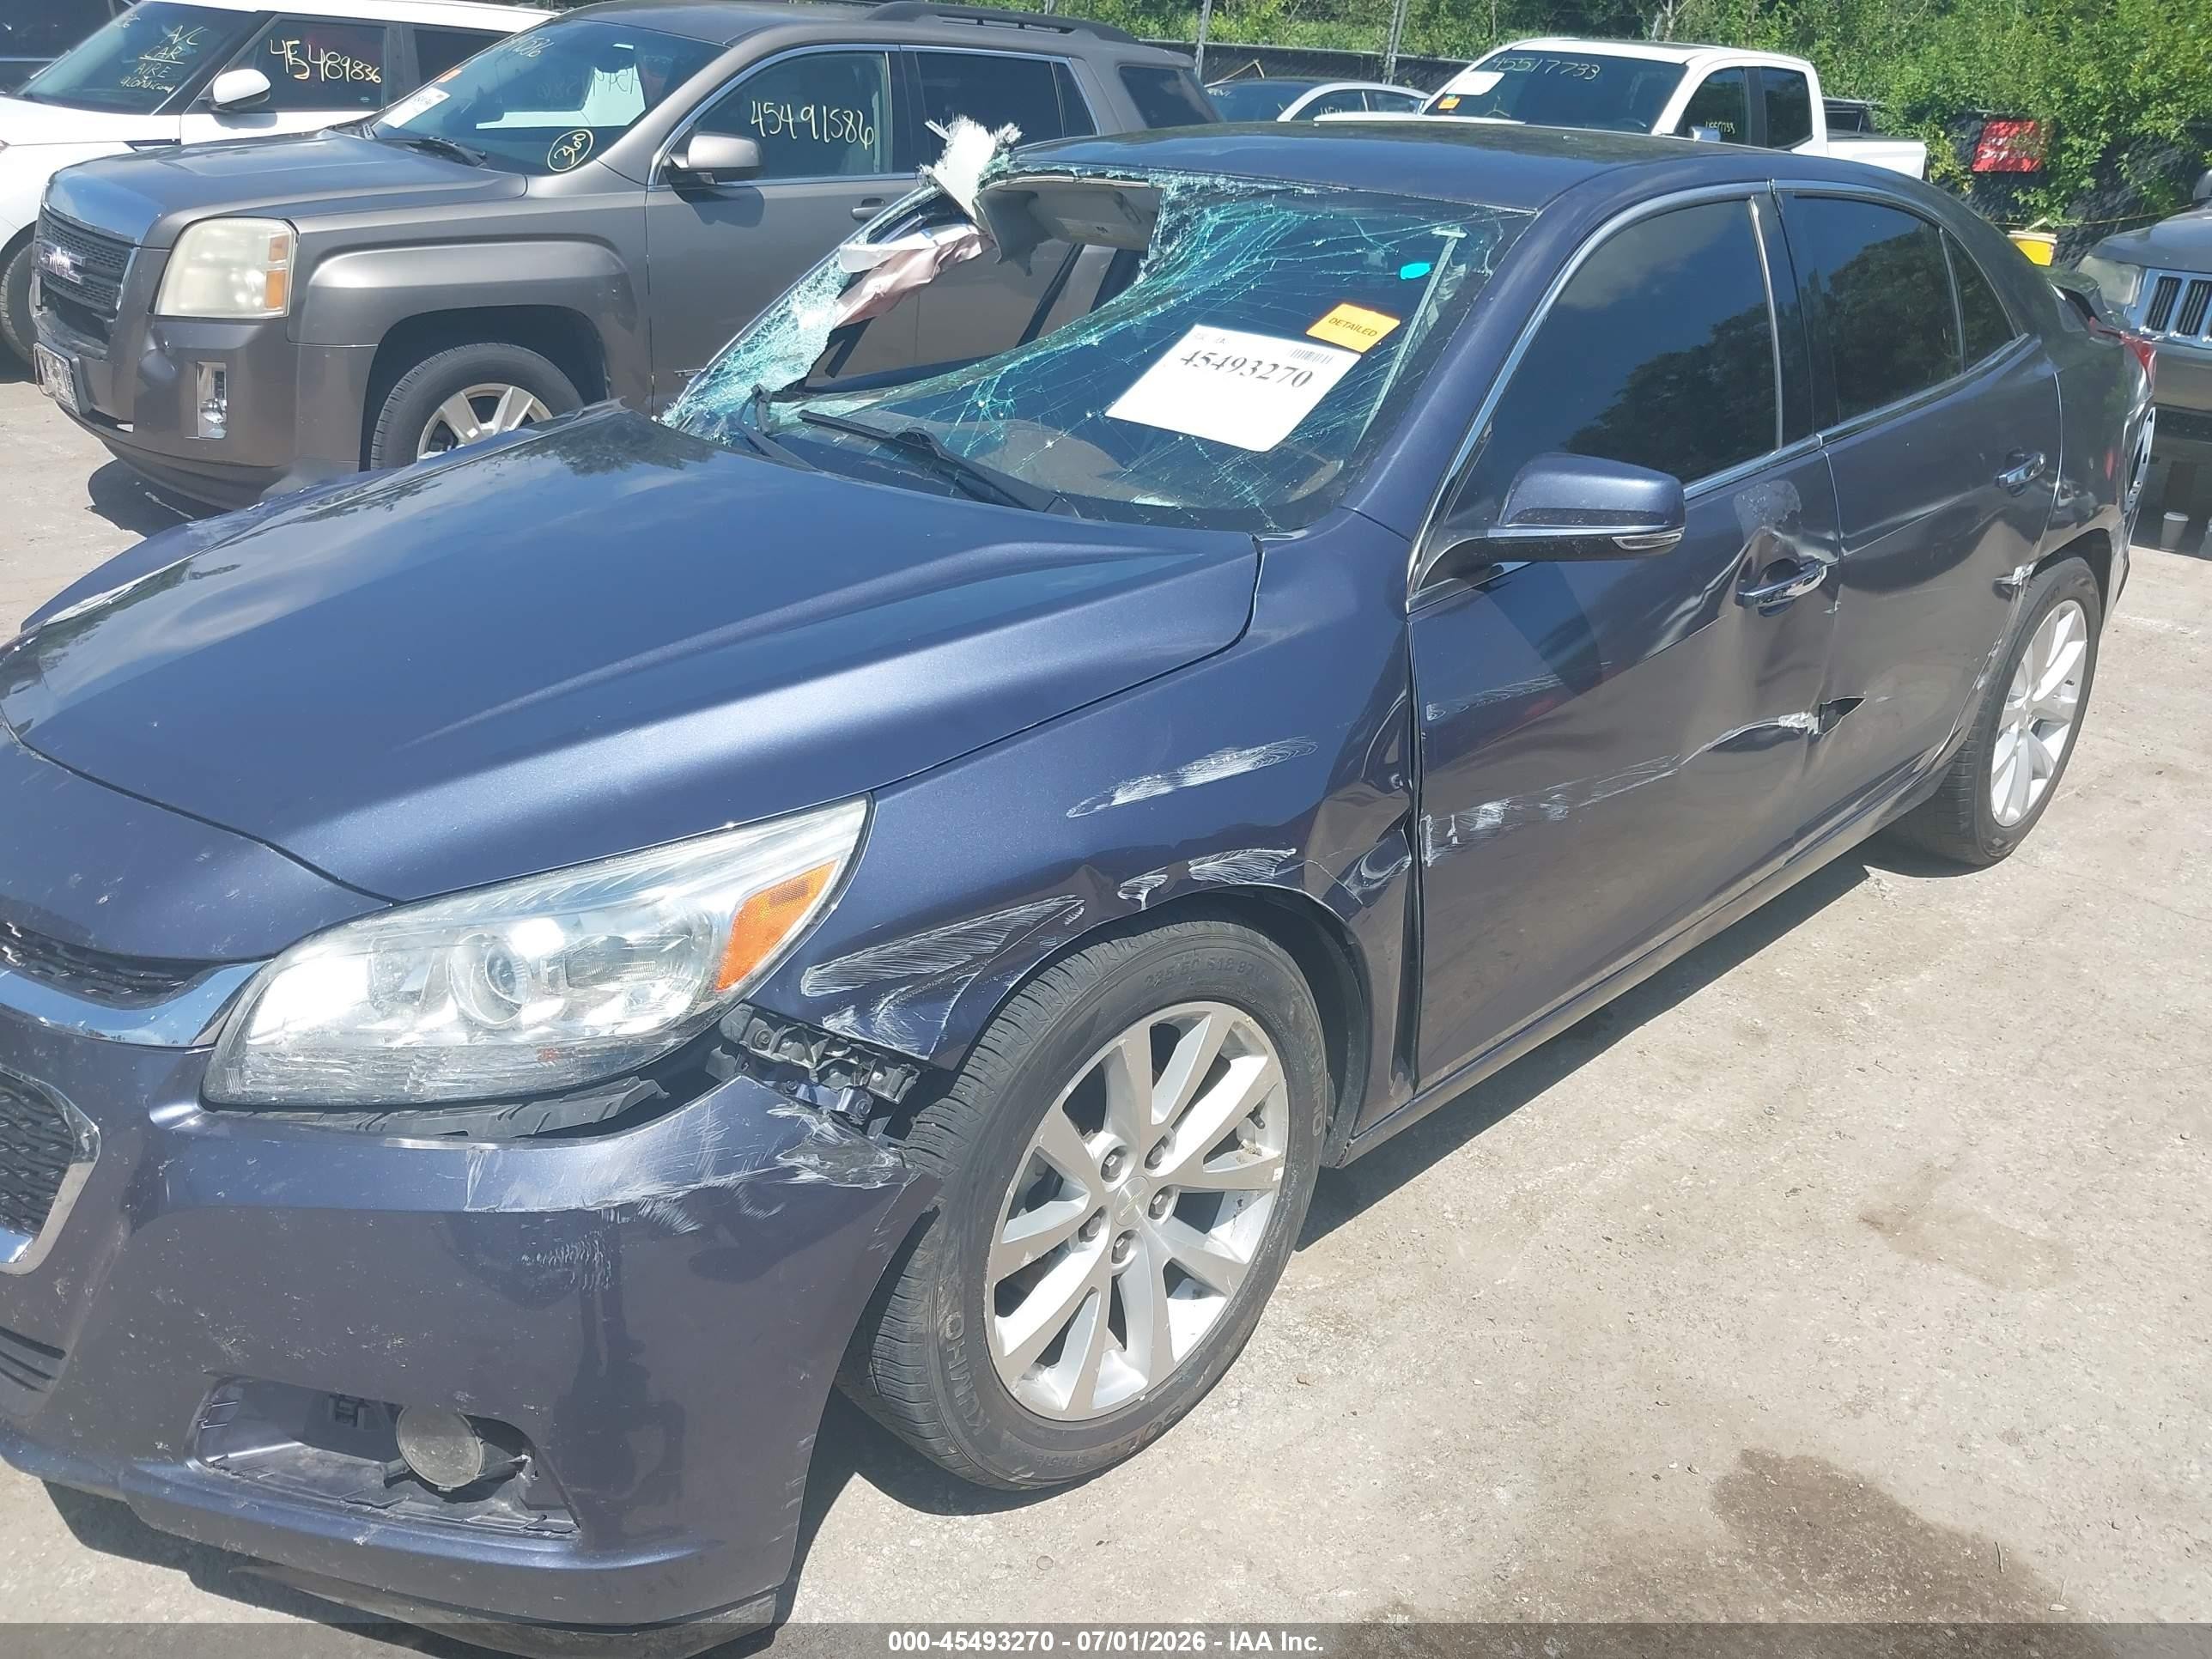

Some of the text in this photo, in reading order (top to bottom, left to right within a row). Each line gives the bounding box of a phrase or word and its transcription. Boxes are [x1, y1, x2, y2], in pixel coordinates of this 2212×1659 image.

[144, 46, 183, 61] CAR
[270, 39, 382, 83] 45489836
[1492, 57, 1601, 80] 45517733
[750, 100, 874, 150] 45491586
[1328, 317, 1378, 337] DETAILED
[1181, 349, 1313, 388] 45493270
